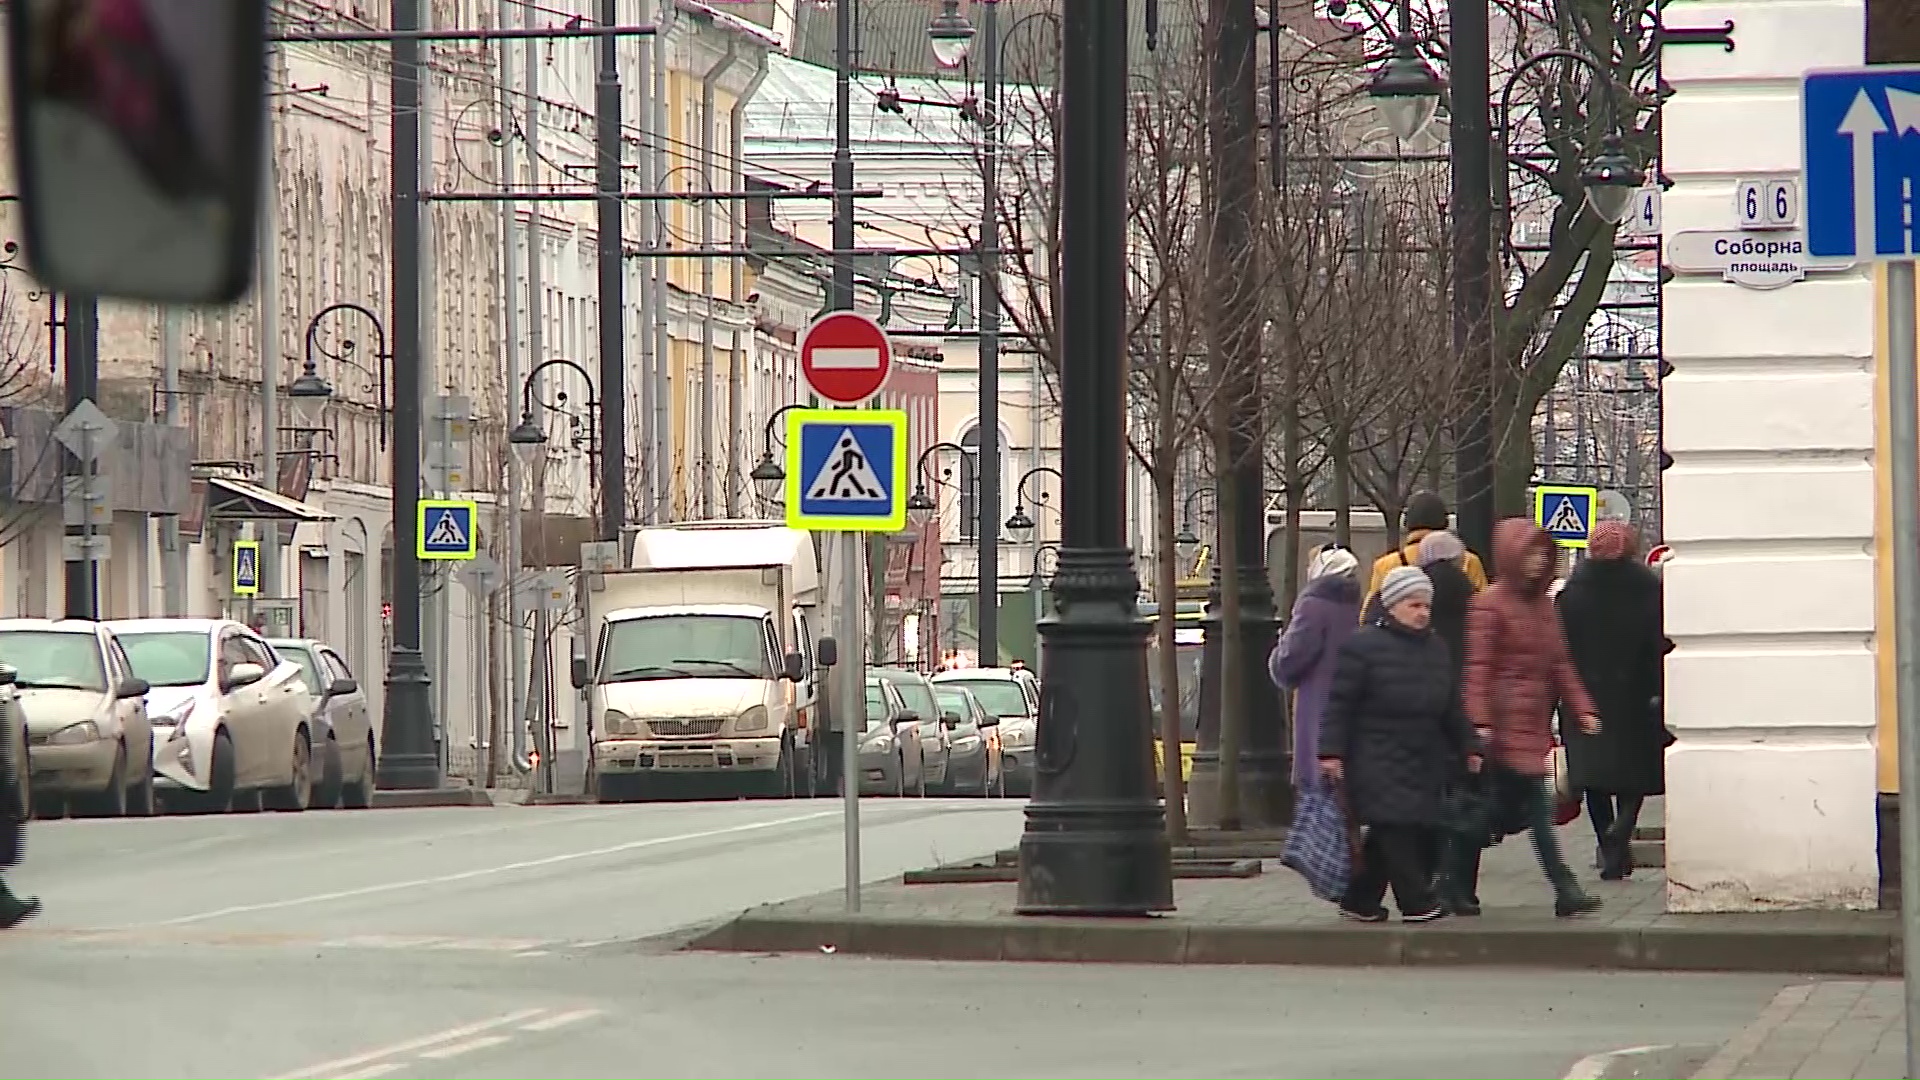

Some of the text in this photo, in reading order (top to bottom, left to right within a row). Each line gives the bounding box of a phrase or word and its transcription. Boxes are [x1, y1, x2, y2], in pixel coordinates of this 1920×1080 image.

[1643, 195, 1653, 226] 4
[1714, 238, 1802, 257] Соборна
[1730, 262, 1798, 273] площадь
